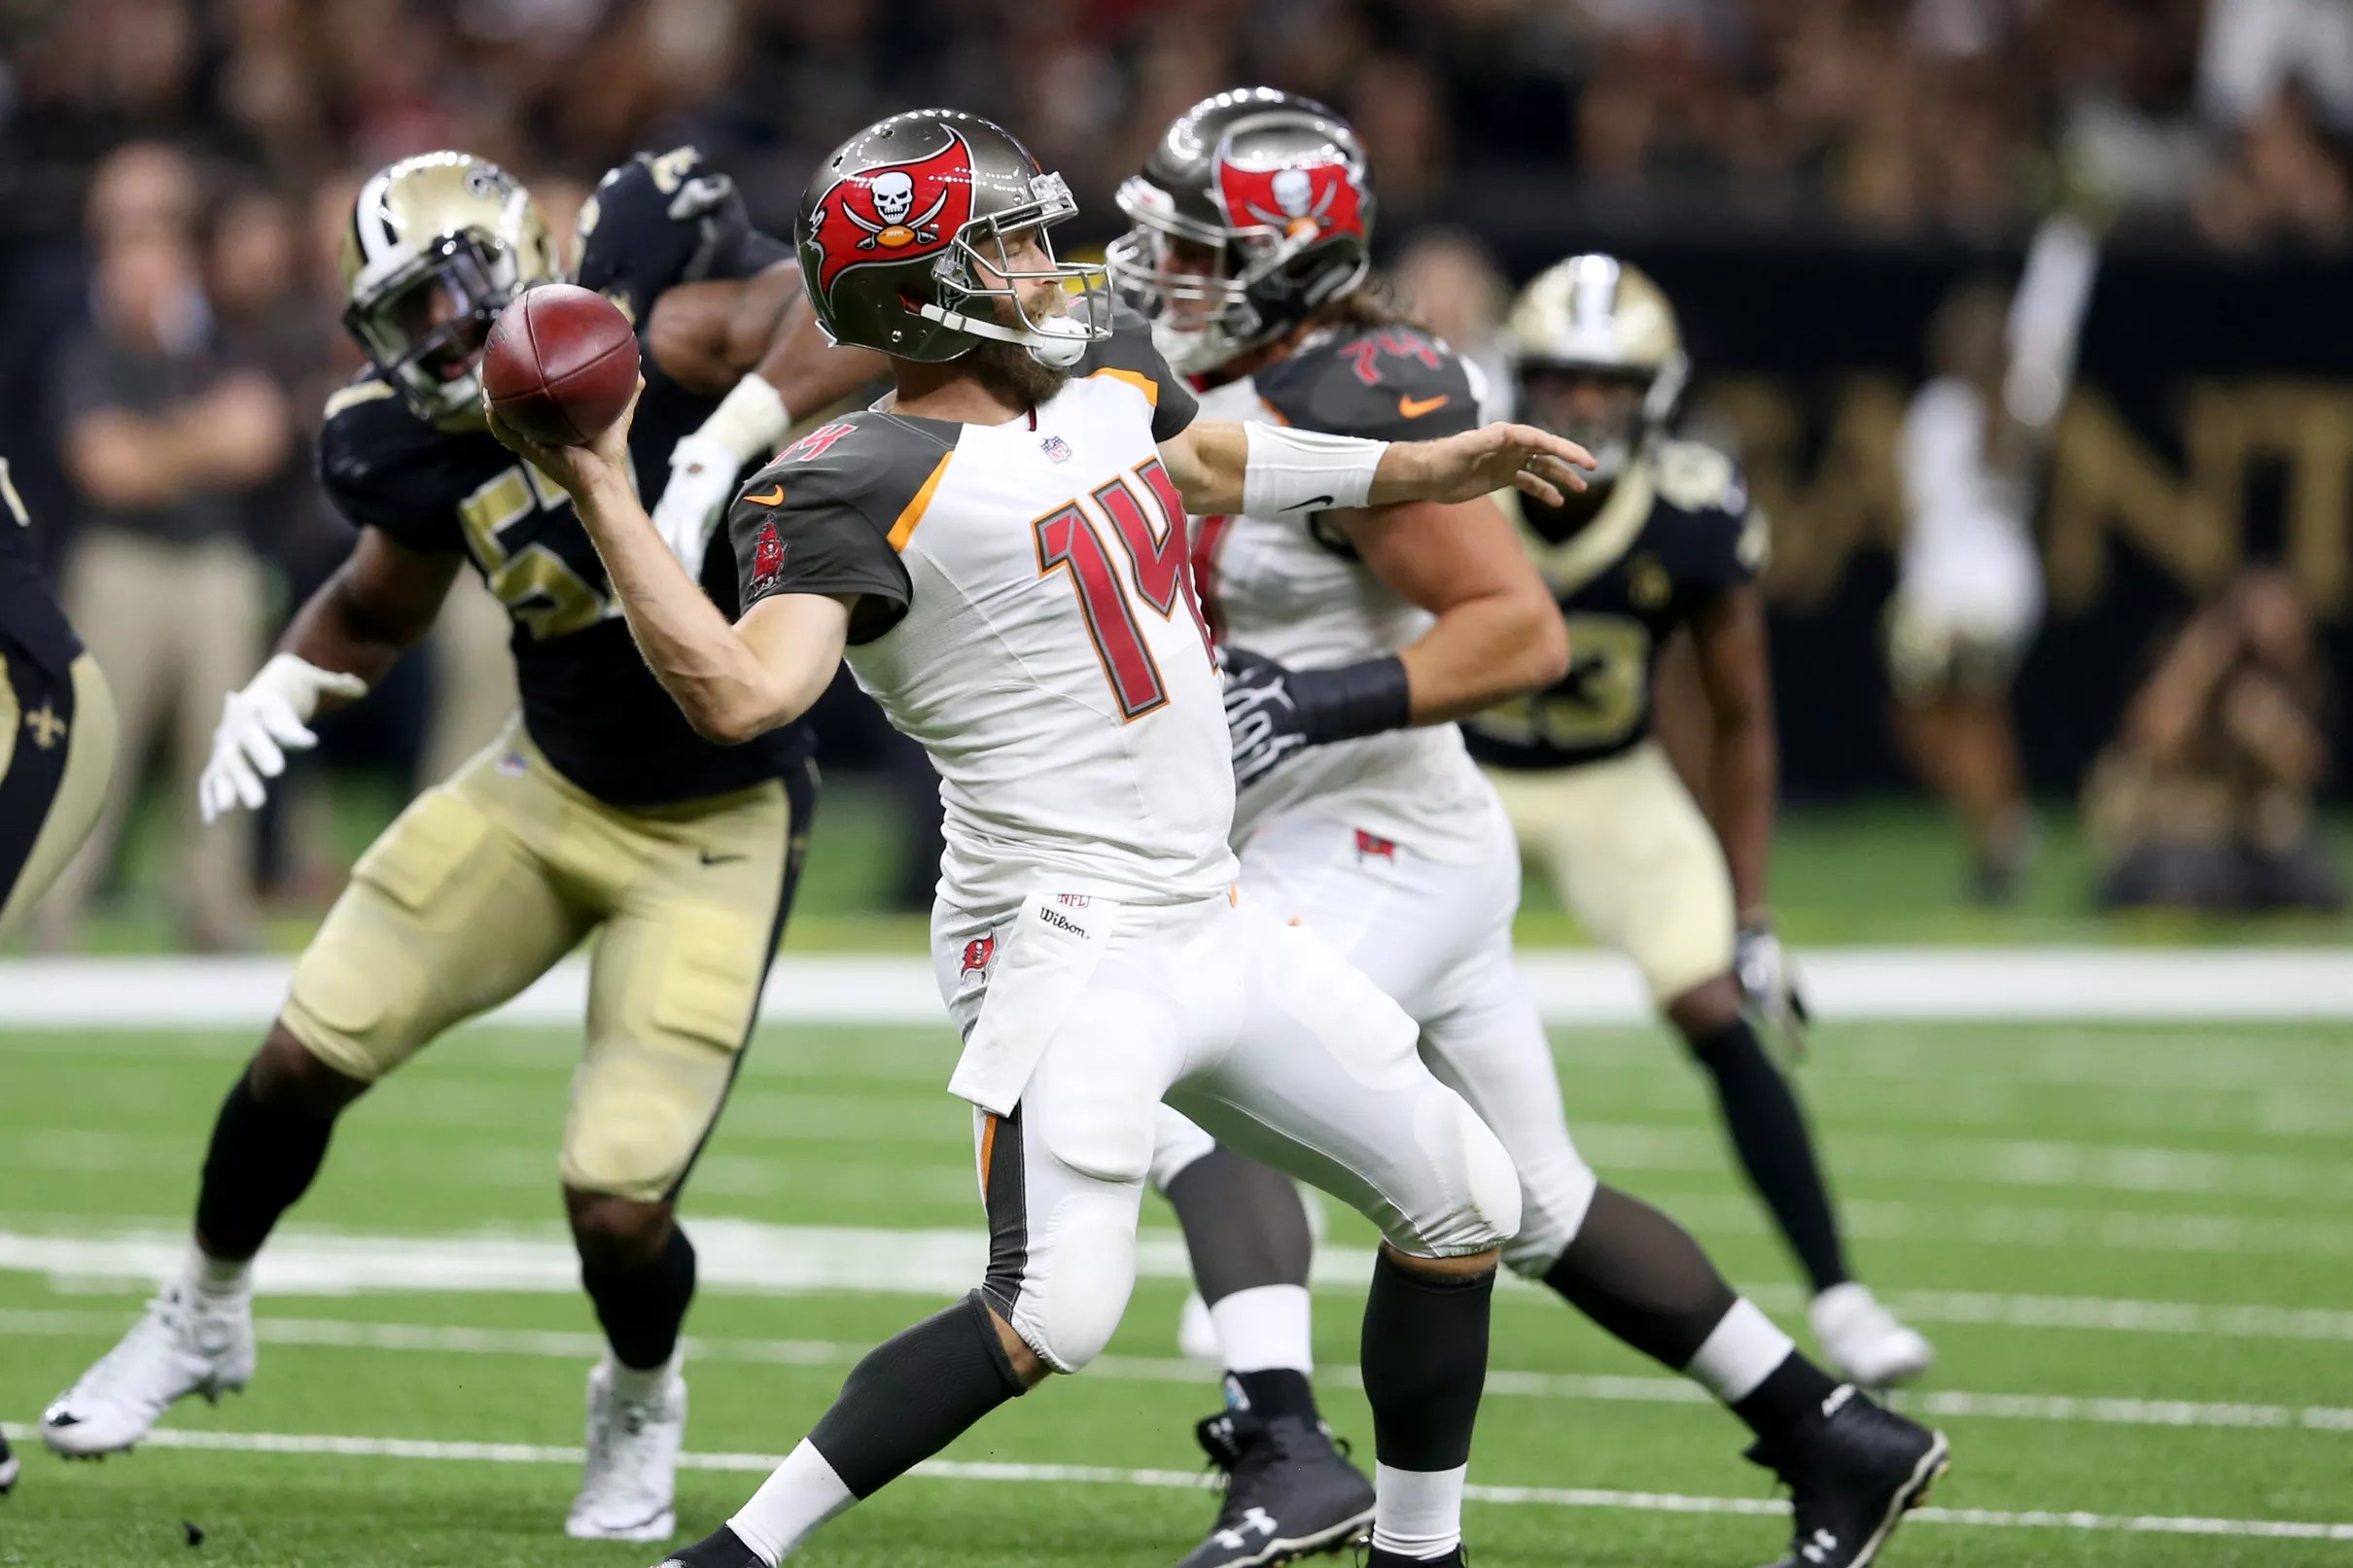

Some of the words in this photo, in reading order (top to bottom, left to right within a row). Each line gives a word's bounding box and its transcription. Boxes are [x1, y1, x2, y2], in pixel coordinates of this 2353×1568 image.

[1336, 333, 1443, 386] 74
[459, 455, 627, 639] 5
[1031, 454, 1219, 724] 14
[1039, 906, 1085, 939] Wilson
[1058, 893, 1087, 908] NFL
